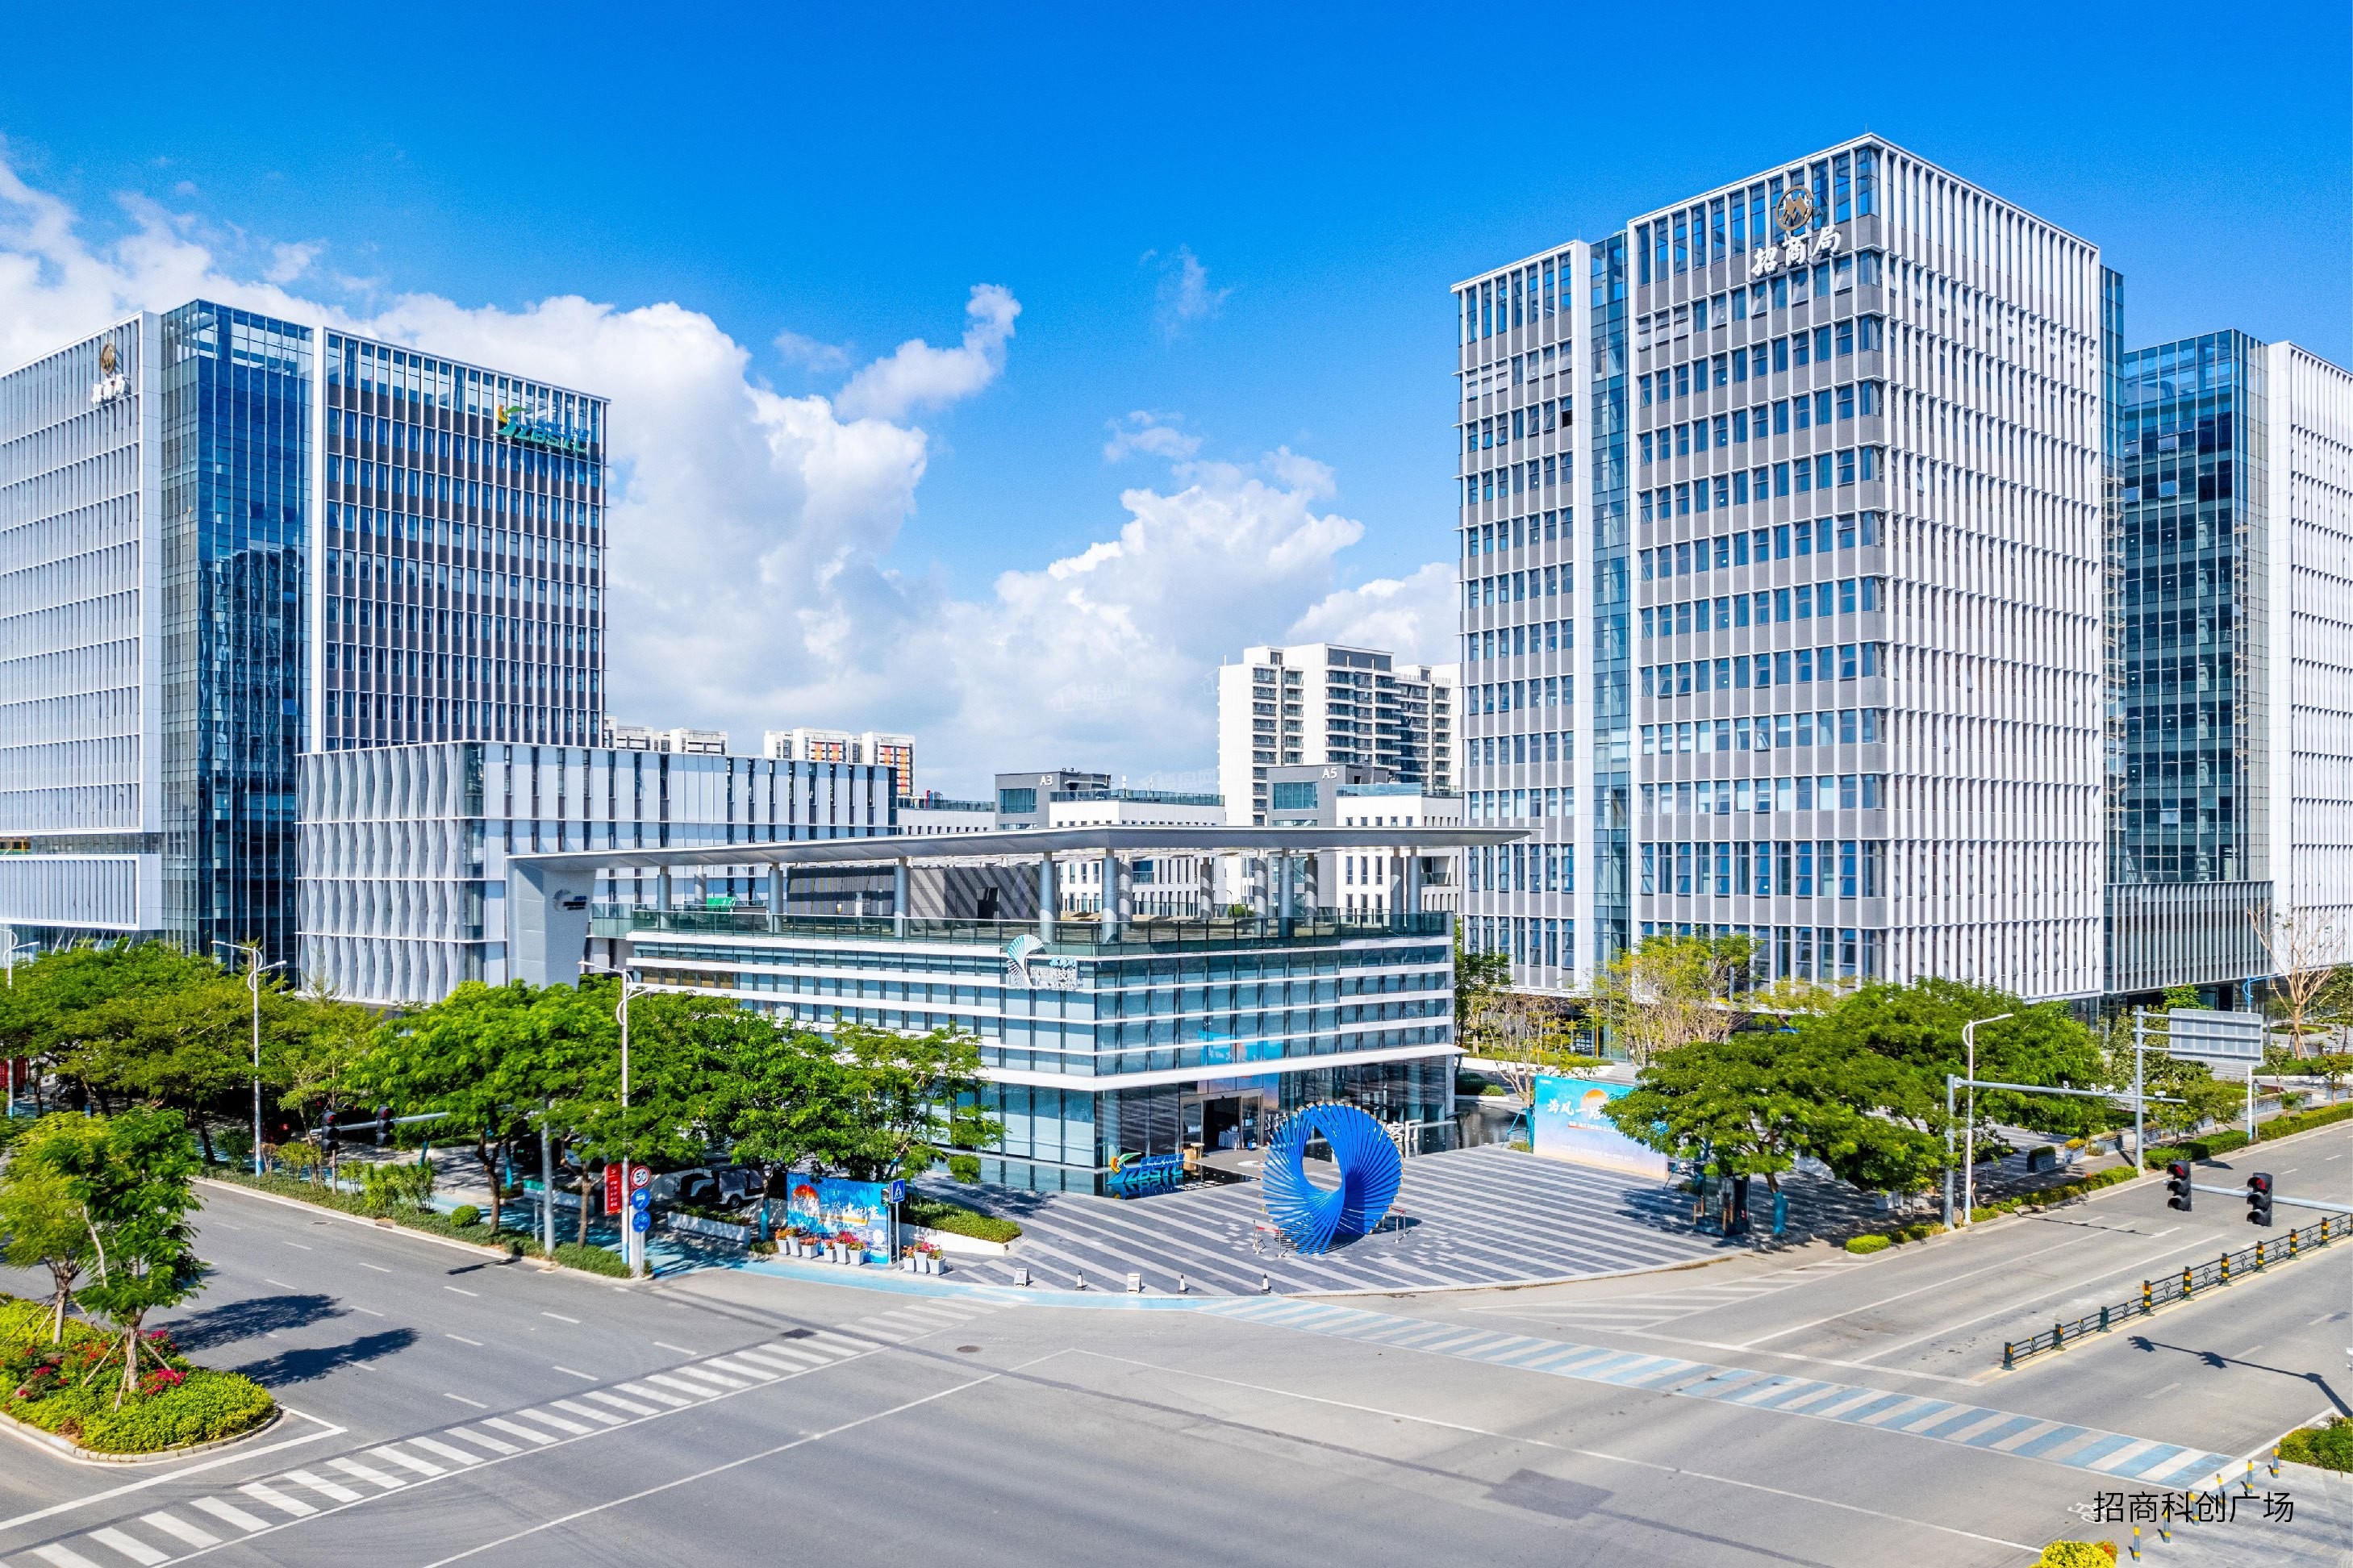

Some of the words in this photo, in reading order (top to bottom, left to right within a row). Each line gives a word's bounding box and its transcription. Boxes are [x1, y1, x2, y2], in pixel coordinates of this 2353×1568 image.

[1750, 225, 1842, 277] 招商局
[1322, 768, 1337, 779] A5
[1040, 775, 1053, 786] A3
[1547, 1098, 1611, 1120] 海风一路
[636, 1171, 647, 1182] 50
